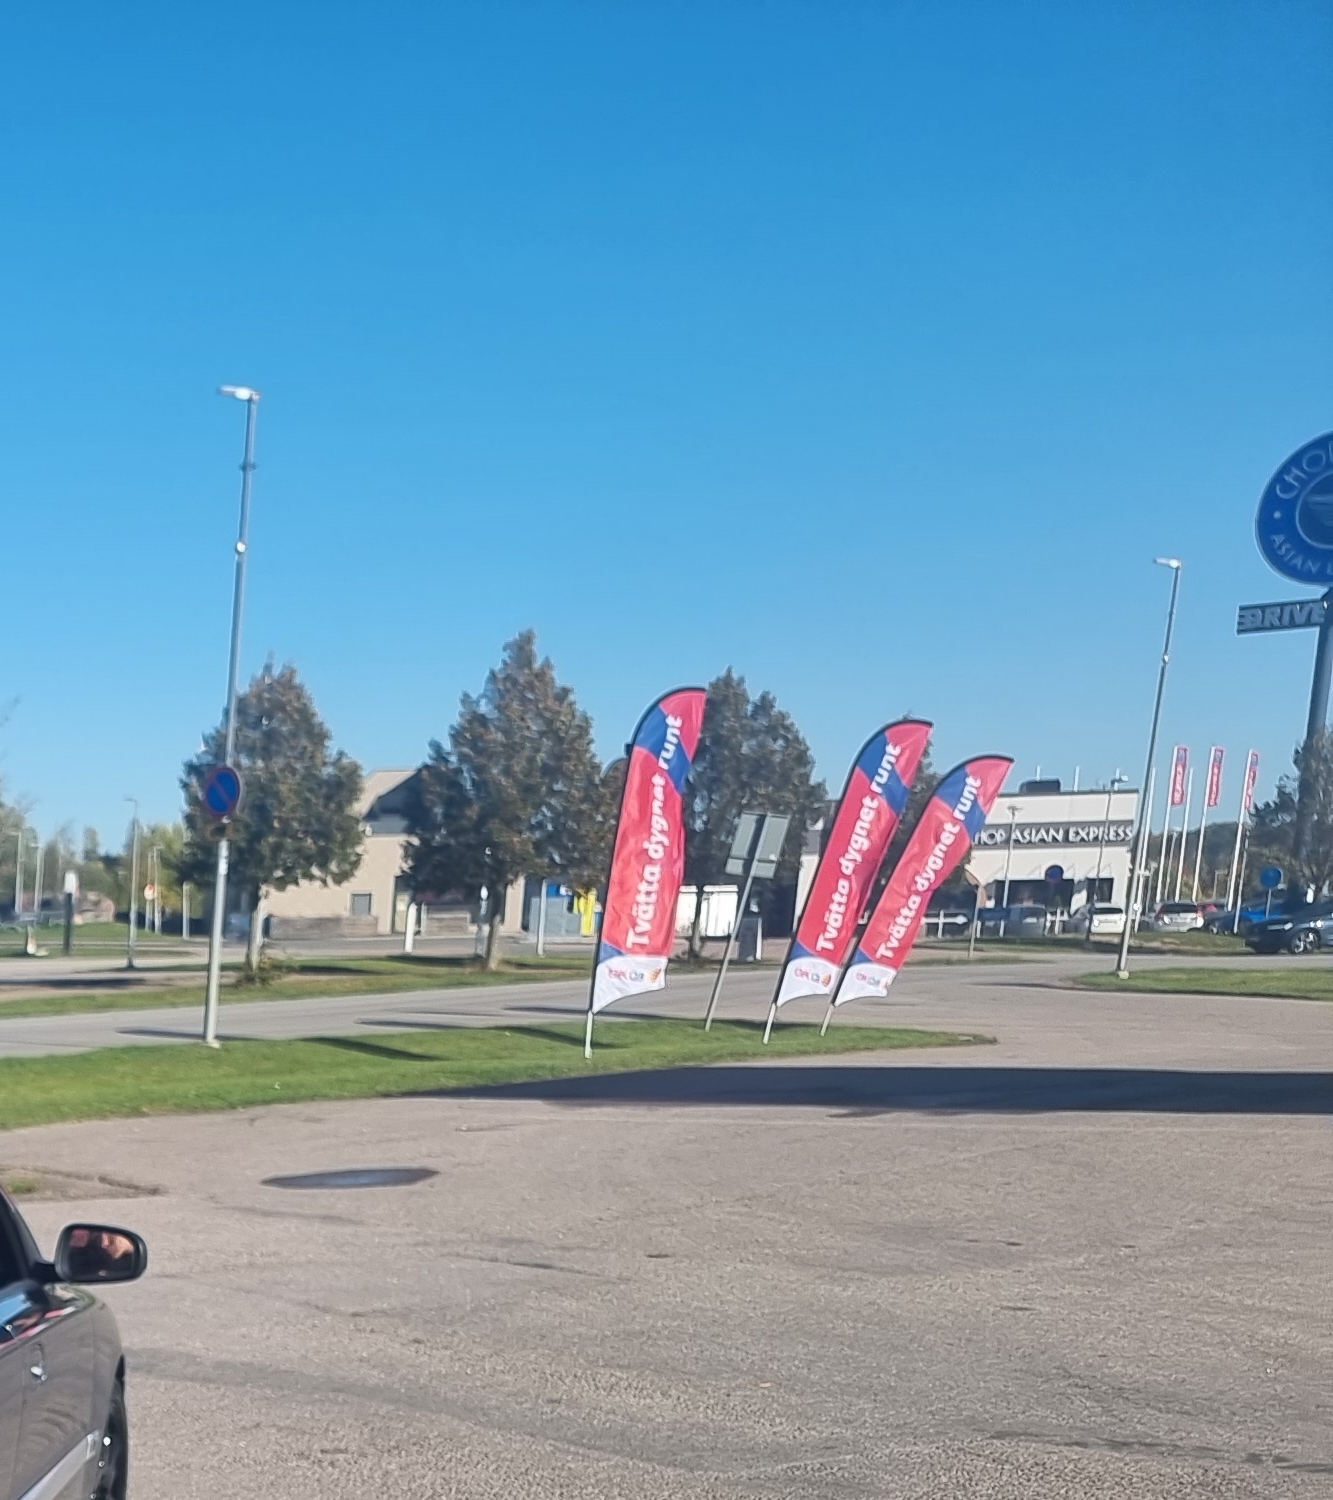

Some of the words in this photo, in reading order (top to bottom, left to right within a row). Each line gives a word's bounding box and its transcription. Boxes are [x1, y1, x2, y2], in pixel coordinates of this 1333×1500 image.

[1271, 534, 1320, 574] ASIAN
[1240, 602, 1325, 630] DRIVE
[658, 714, 683, 770] runt
[642, 772, 669, 860] dygnet
[815, 877, 850, 952] Tvätta
[838, 795, 879, 876] dygnet
[870, 741, 902, 794] runt
[974, 828, 1007, 846] HOP
[1013, 826, 1064, 844] ASIAN
[1068, 825, 1133, 843] EXPRESS
[876, 893, 922, 960] Tvätta
[953, 774, 983, 821] runt
[626, 863, 662, 949] Tvätta
